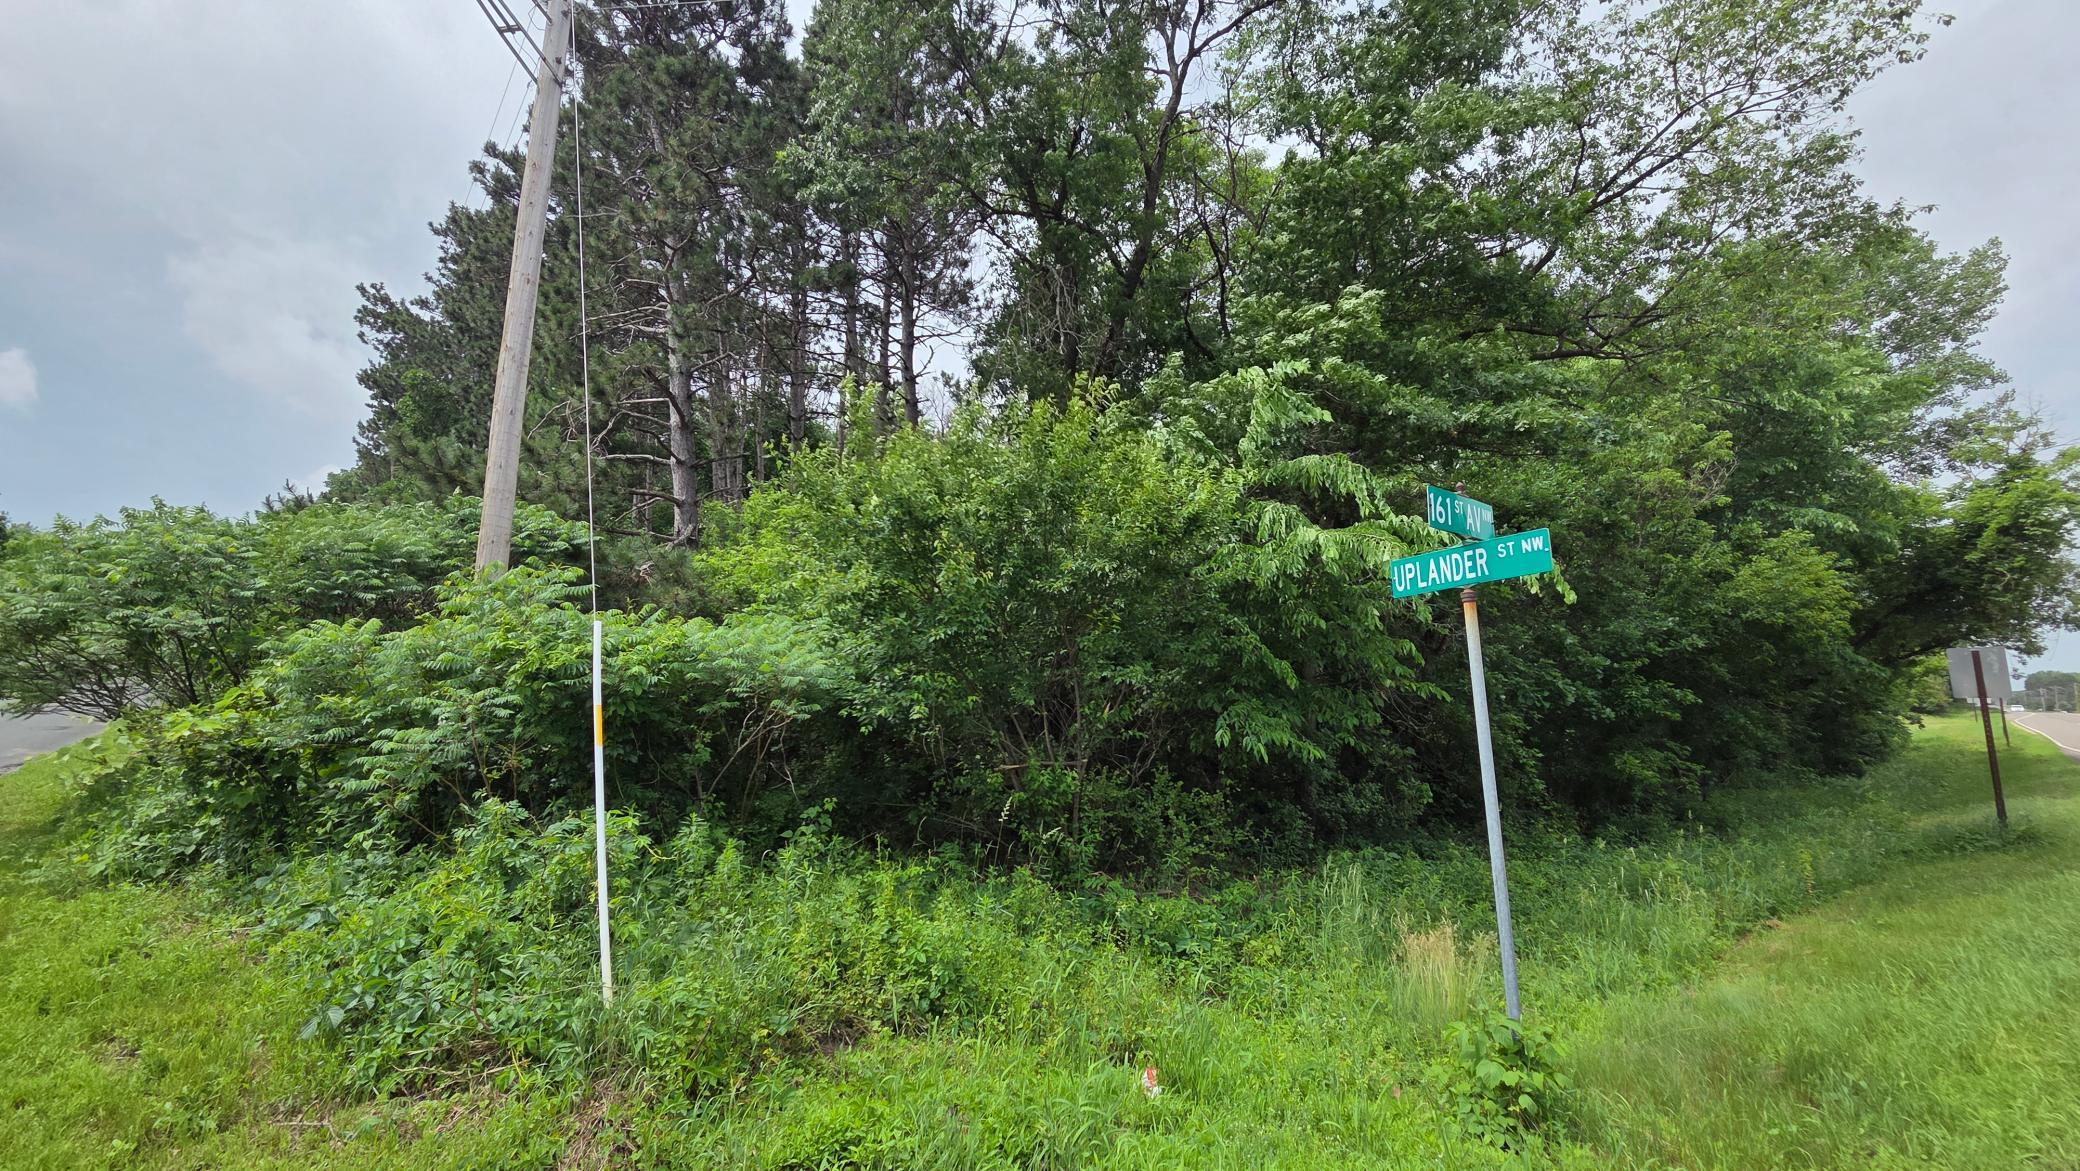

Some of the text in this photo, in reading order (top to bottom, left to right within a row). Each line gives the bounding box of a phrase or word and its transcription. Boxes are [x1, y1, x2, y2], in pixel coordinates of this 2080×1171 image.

[1466, 503, 1481, 533] AV
[1393, 547, 1489, 592] UPLANDER
[1497, 541, 1515, 558] ST
